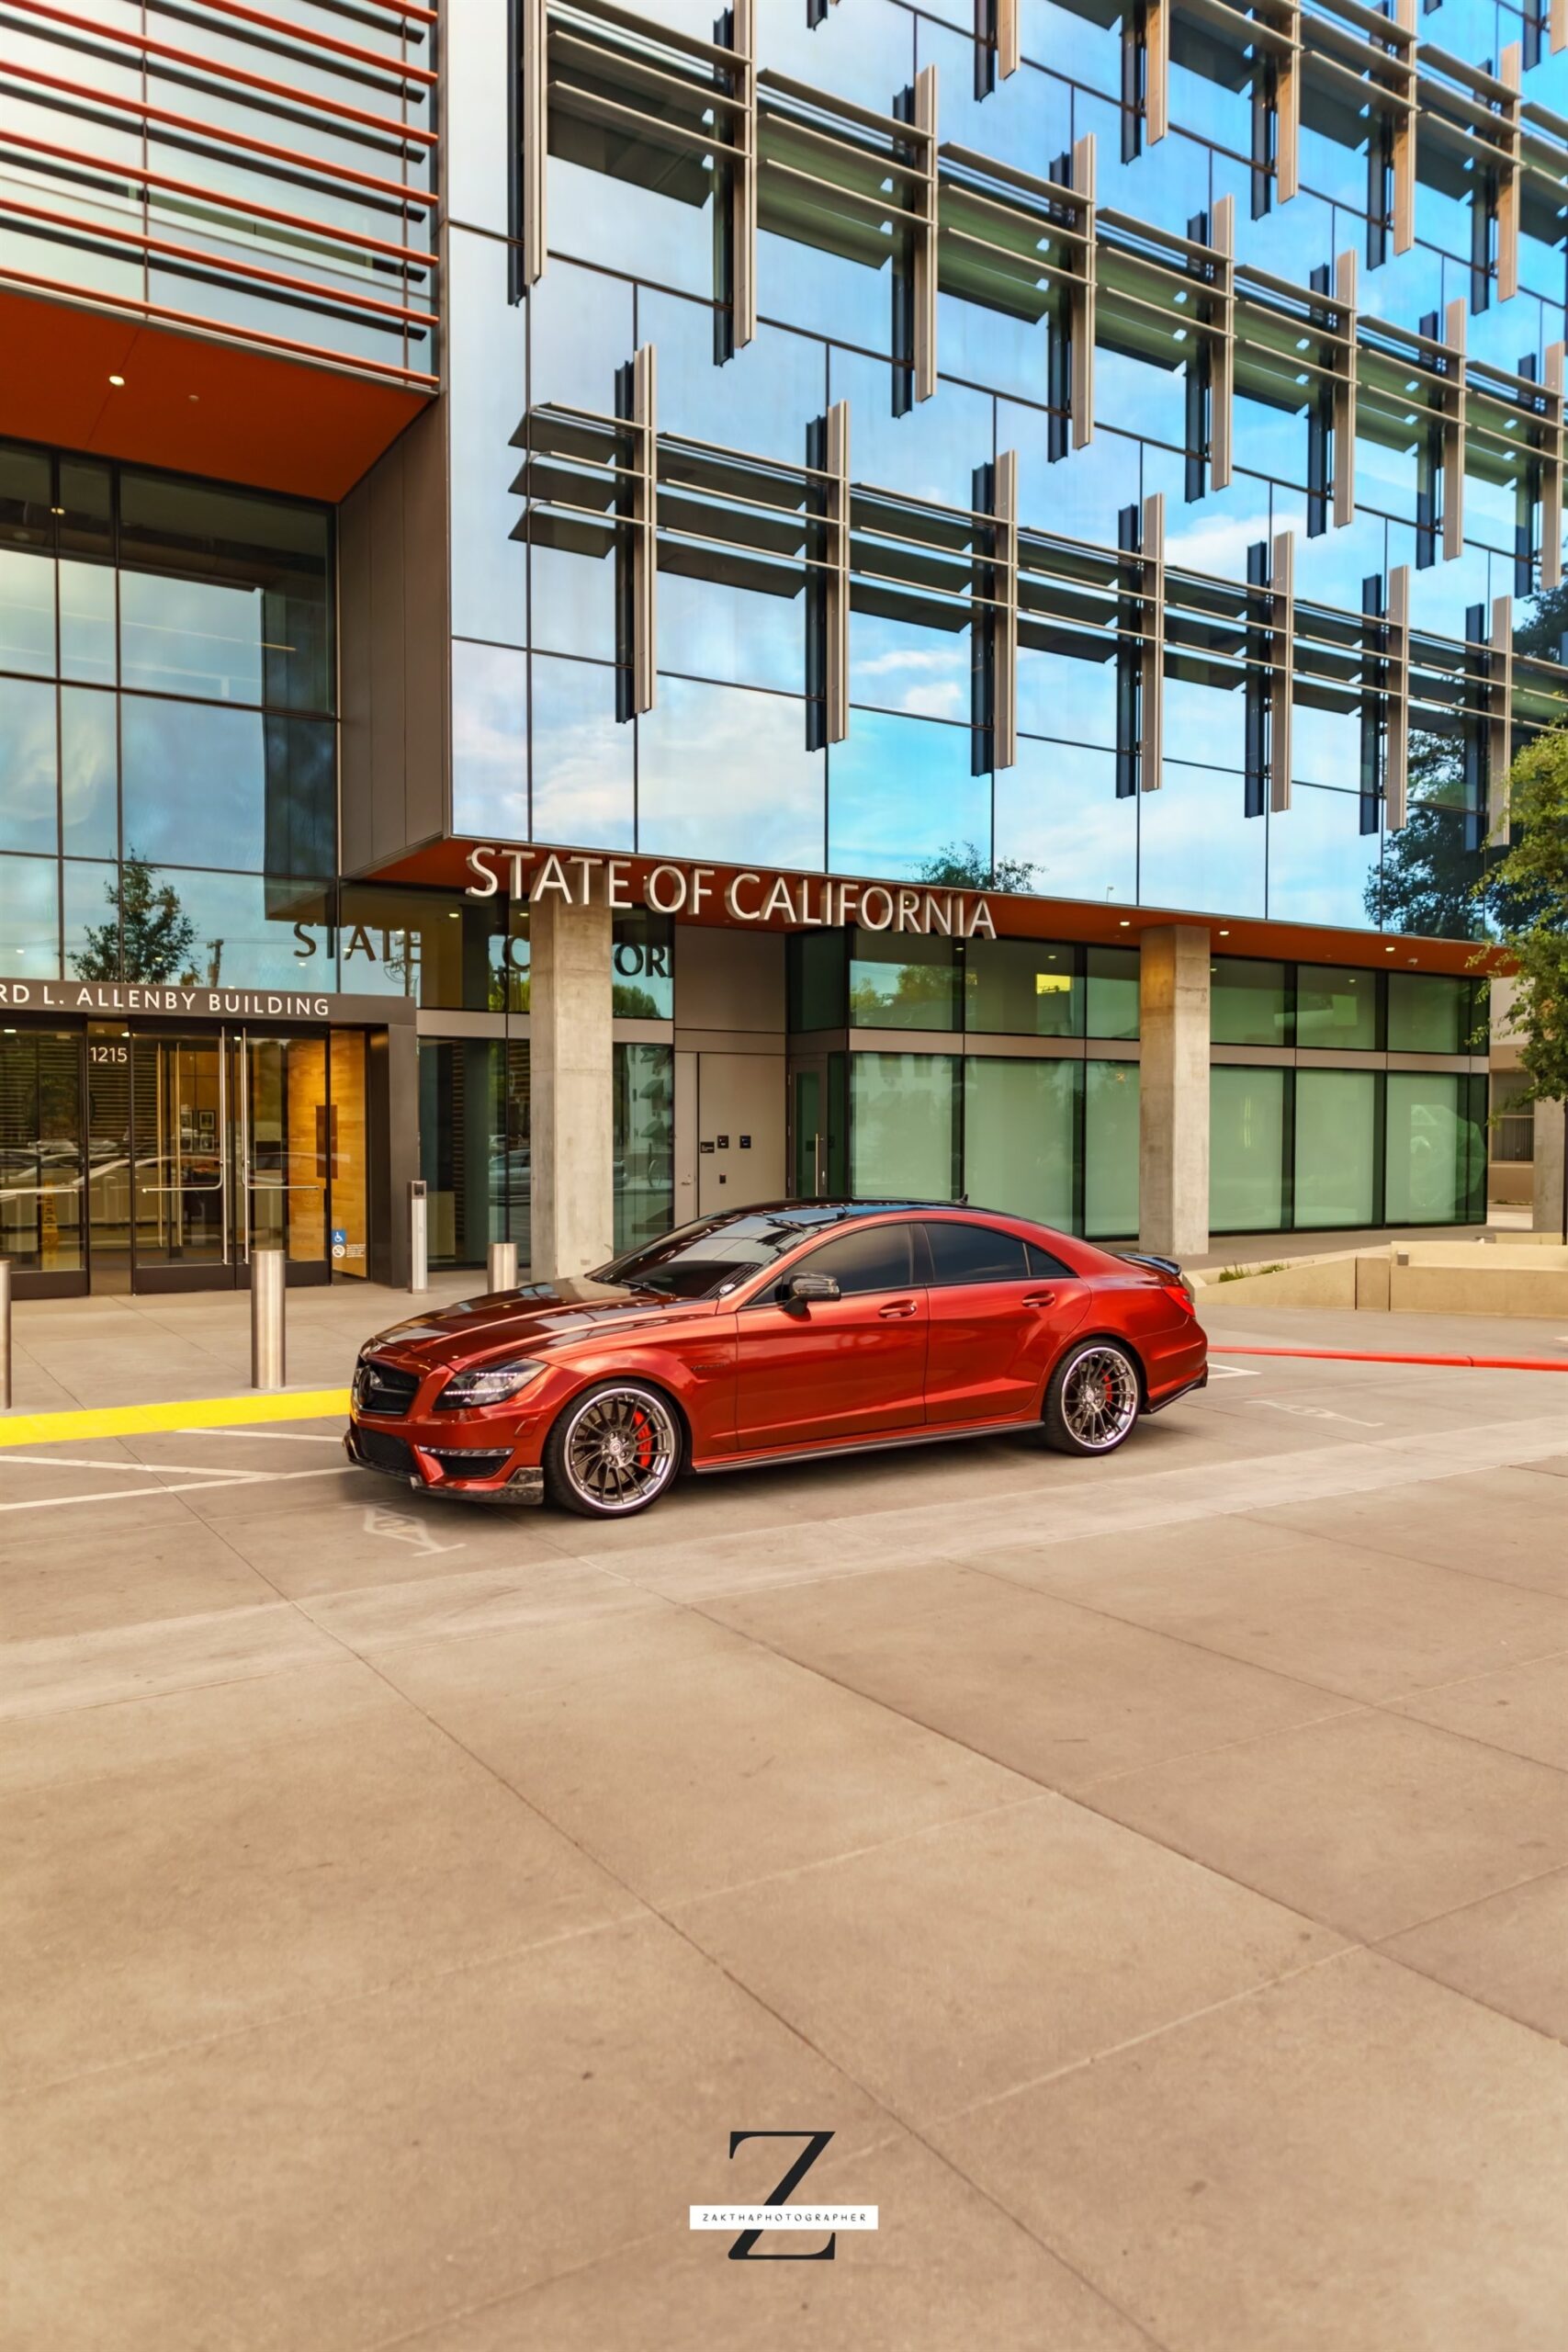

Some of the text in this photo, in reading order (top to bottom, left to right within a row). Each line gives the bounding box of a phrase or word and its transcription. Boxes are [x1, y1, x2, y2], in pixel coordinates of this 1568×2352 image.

[466, 846, 997, 940] STATE OF CALIFORNIA
[43, 986, 64, 1004] L.
[76, 988, 197, 1011] ALLENBY
[209, 993, 330, 1016] BUILDING
[90, 1046, 128, 1063] 1215
